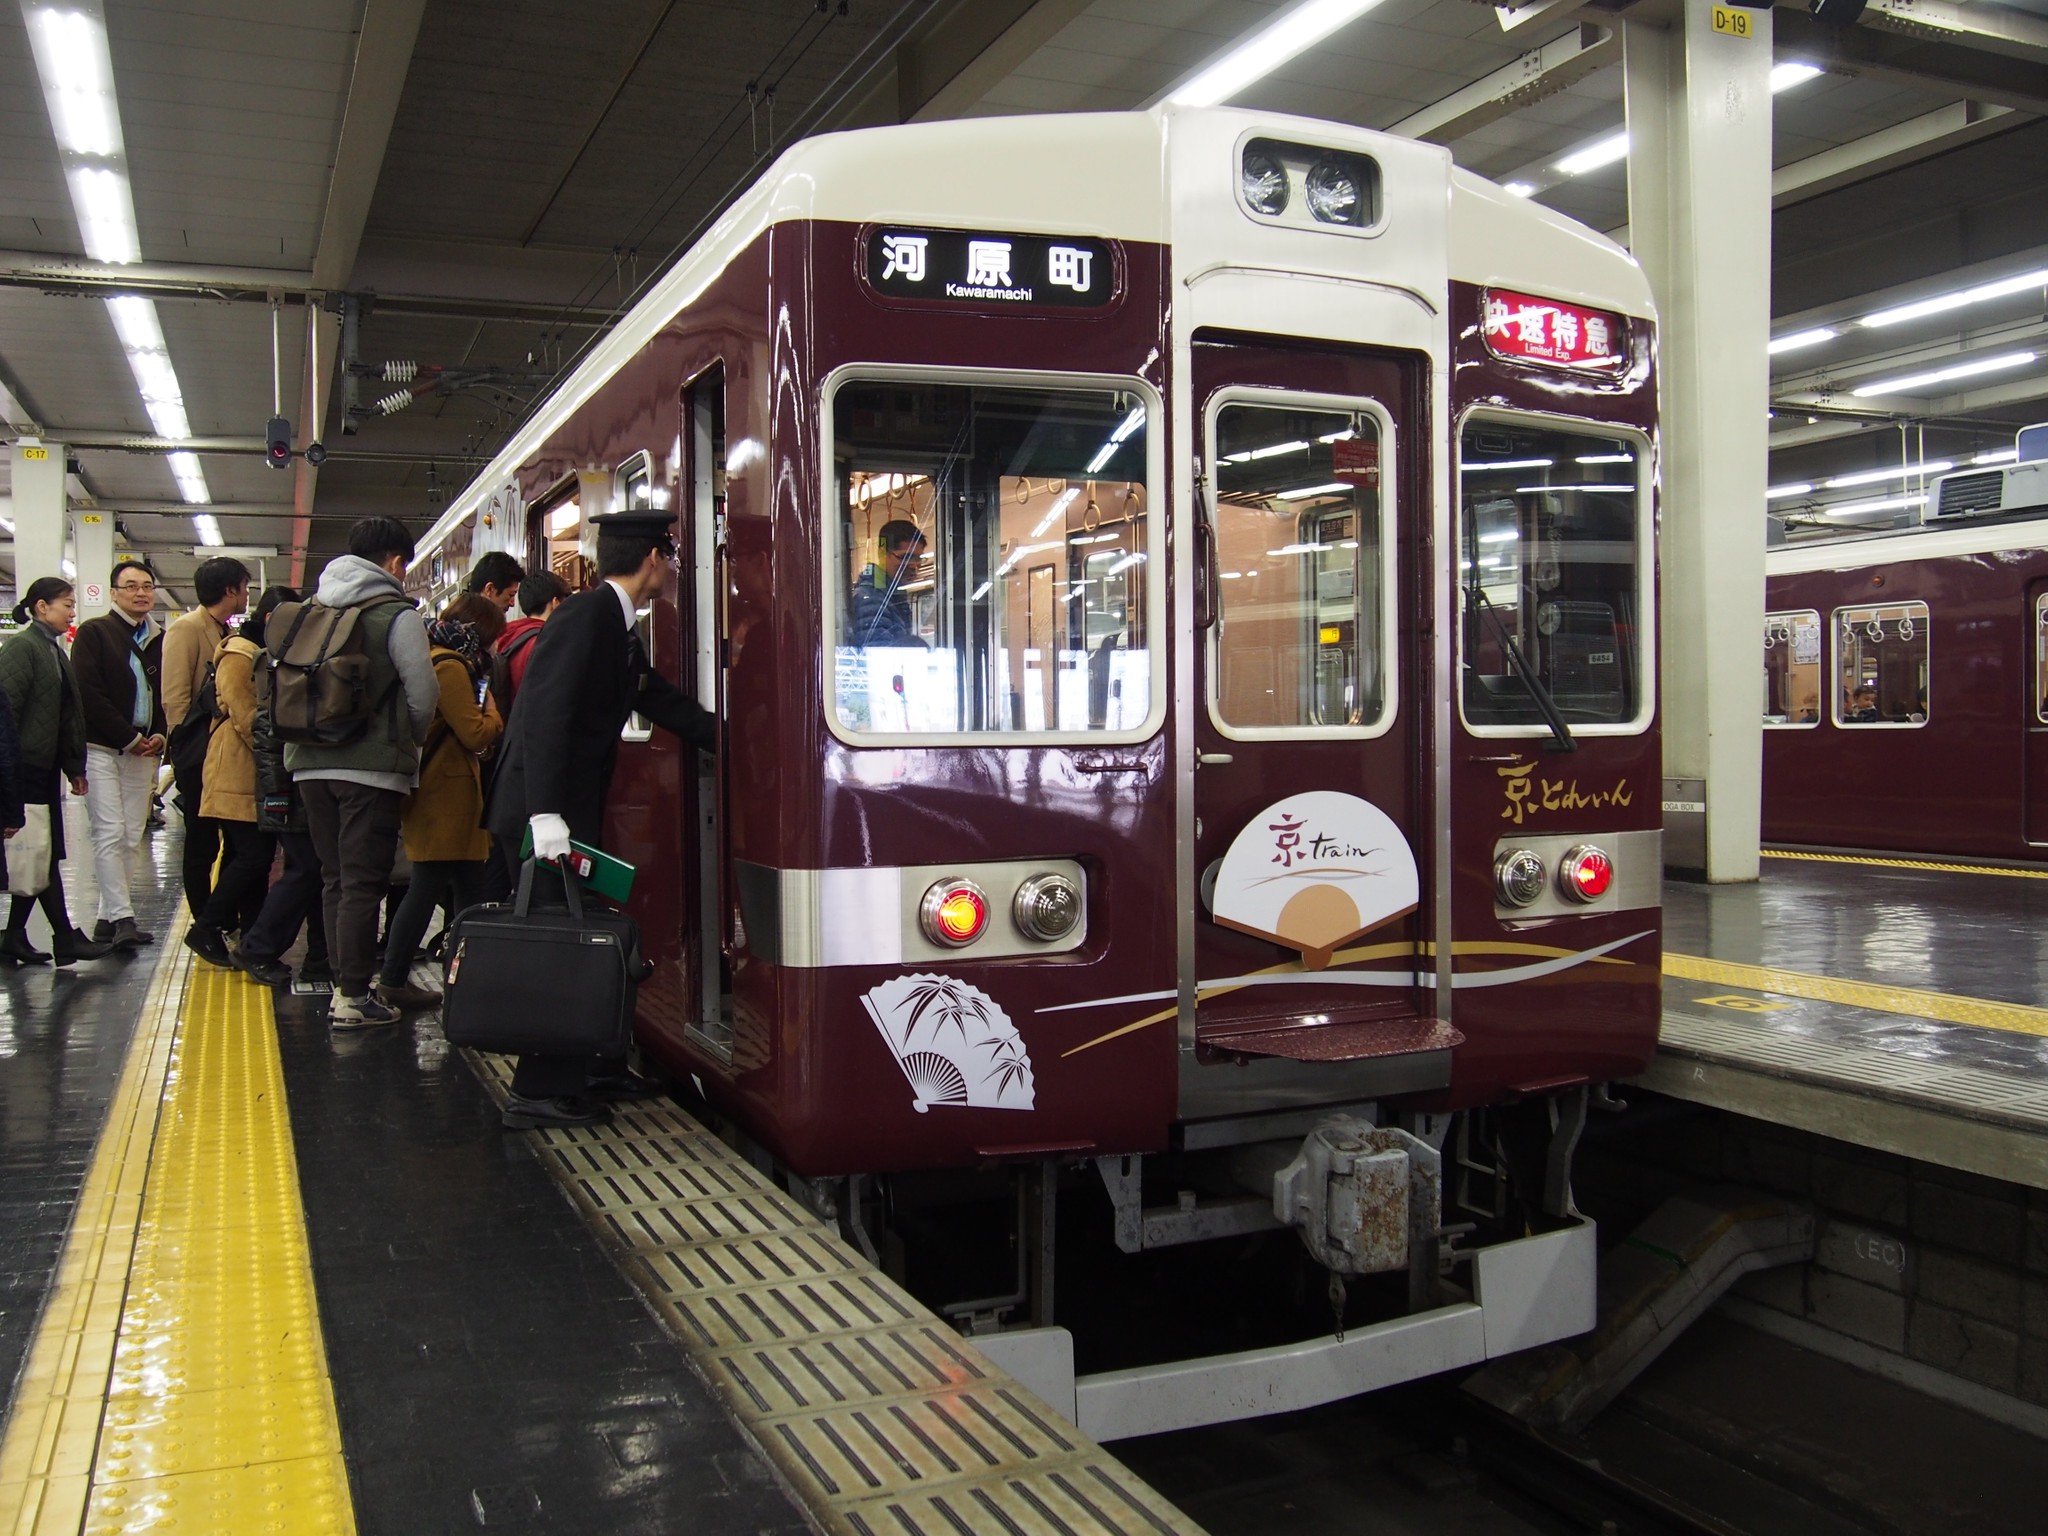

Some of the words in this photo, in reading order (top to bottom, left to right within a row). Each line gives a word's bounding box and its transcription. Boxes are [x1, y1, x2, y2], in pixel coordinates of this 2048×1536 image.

[1716, 10, 1746, 34] D-19
[946, 283, 1033, 301] Kawaramachi
[1486, 298, 1610, 356] 快速特急
[1525, 342, 1553, 357] Limited
[1555, 348, 1572, 361] Exp.
[26, 450, 45, 459] C-17
[1497, 753, 1633, 824] 京とれいん
[1680, 803, 1695, 811] BOX
